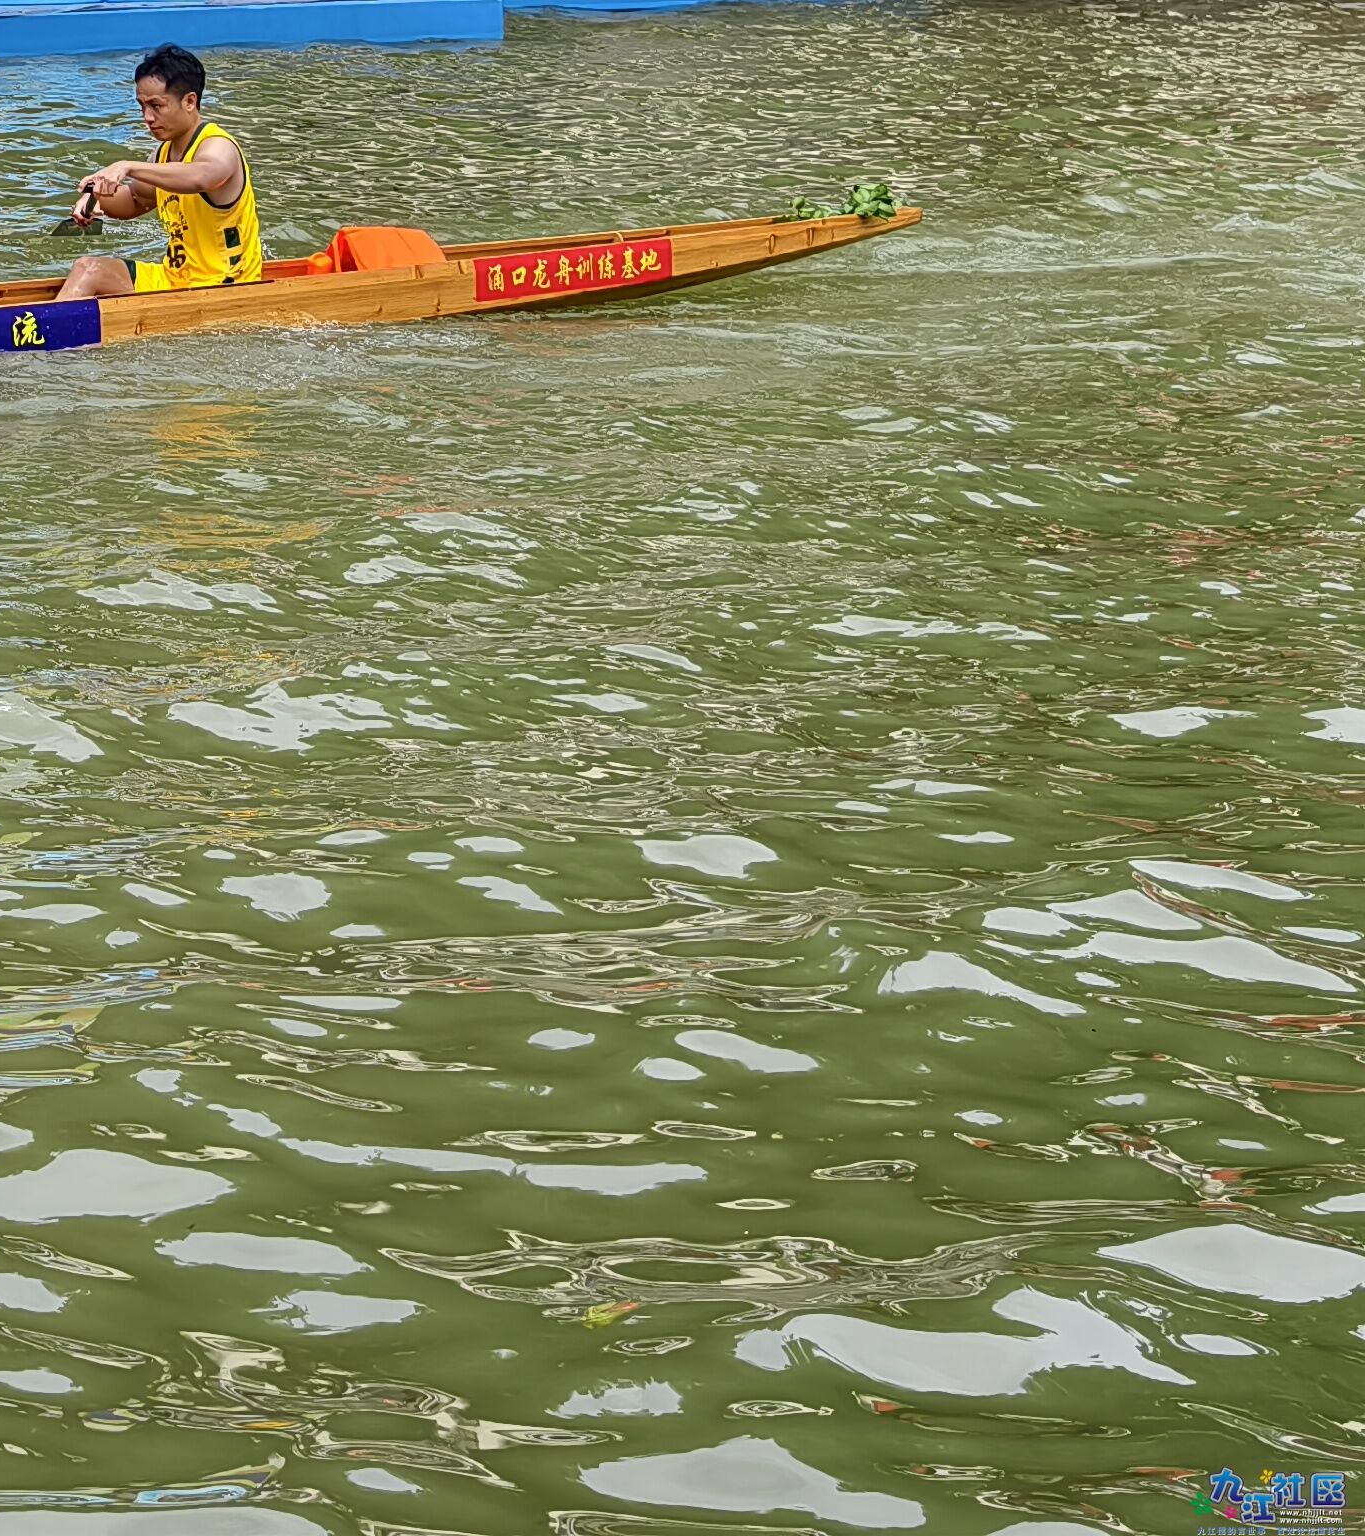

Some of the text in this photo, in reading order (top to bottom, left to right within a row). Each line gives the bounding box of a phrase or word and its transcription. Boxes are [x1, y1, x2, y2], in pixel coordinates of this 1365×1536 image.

[486, 247, 664, 293] 涌口龙舟训练基地
